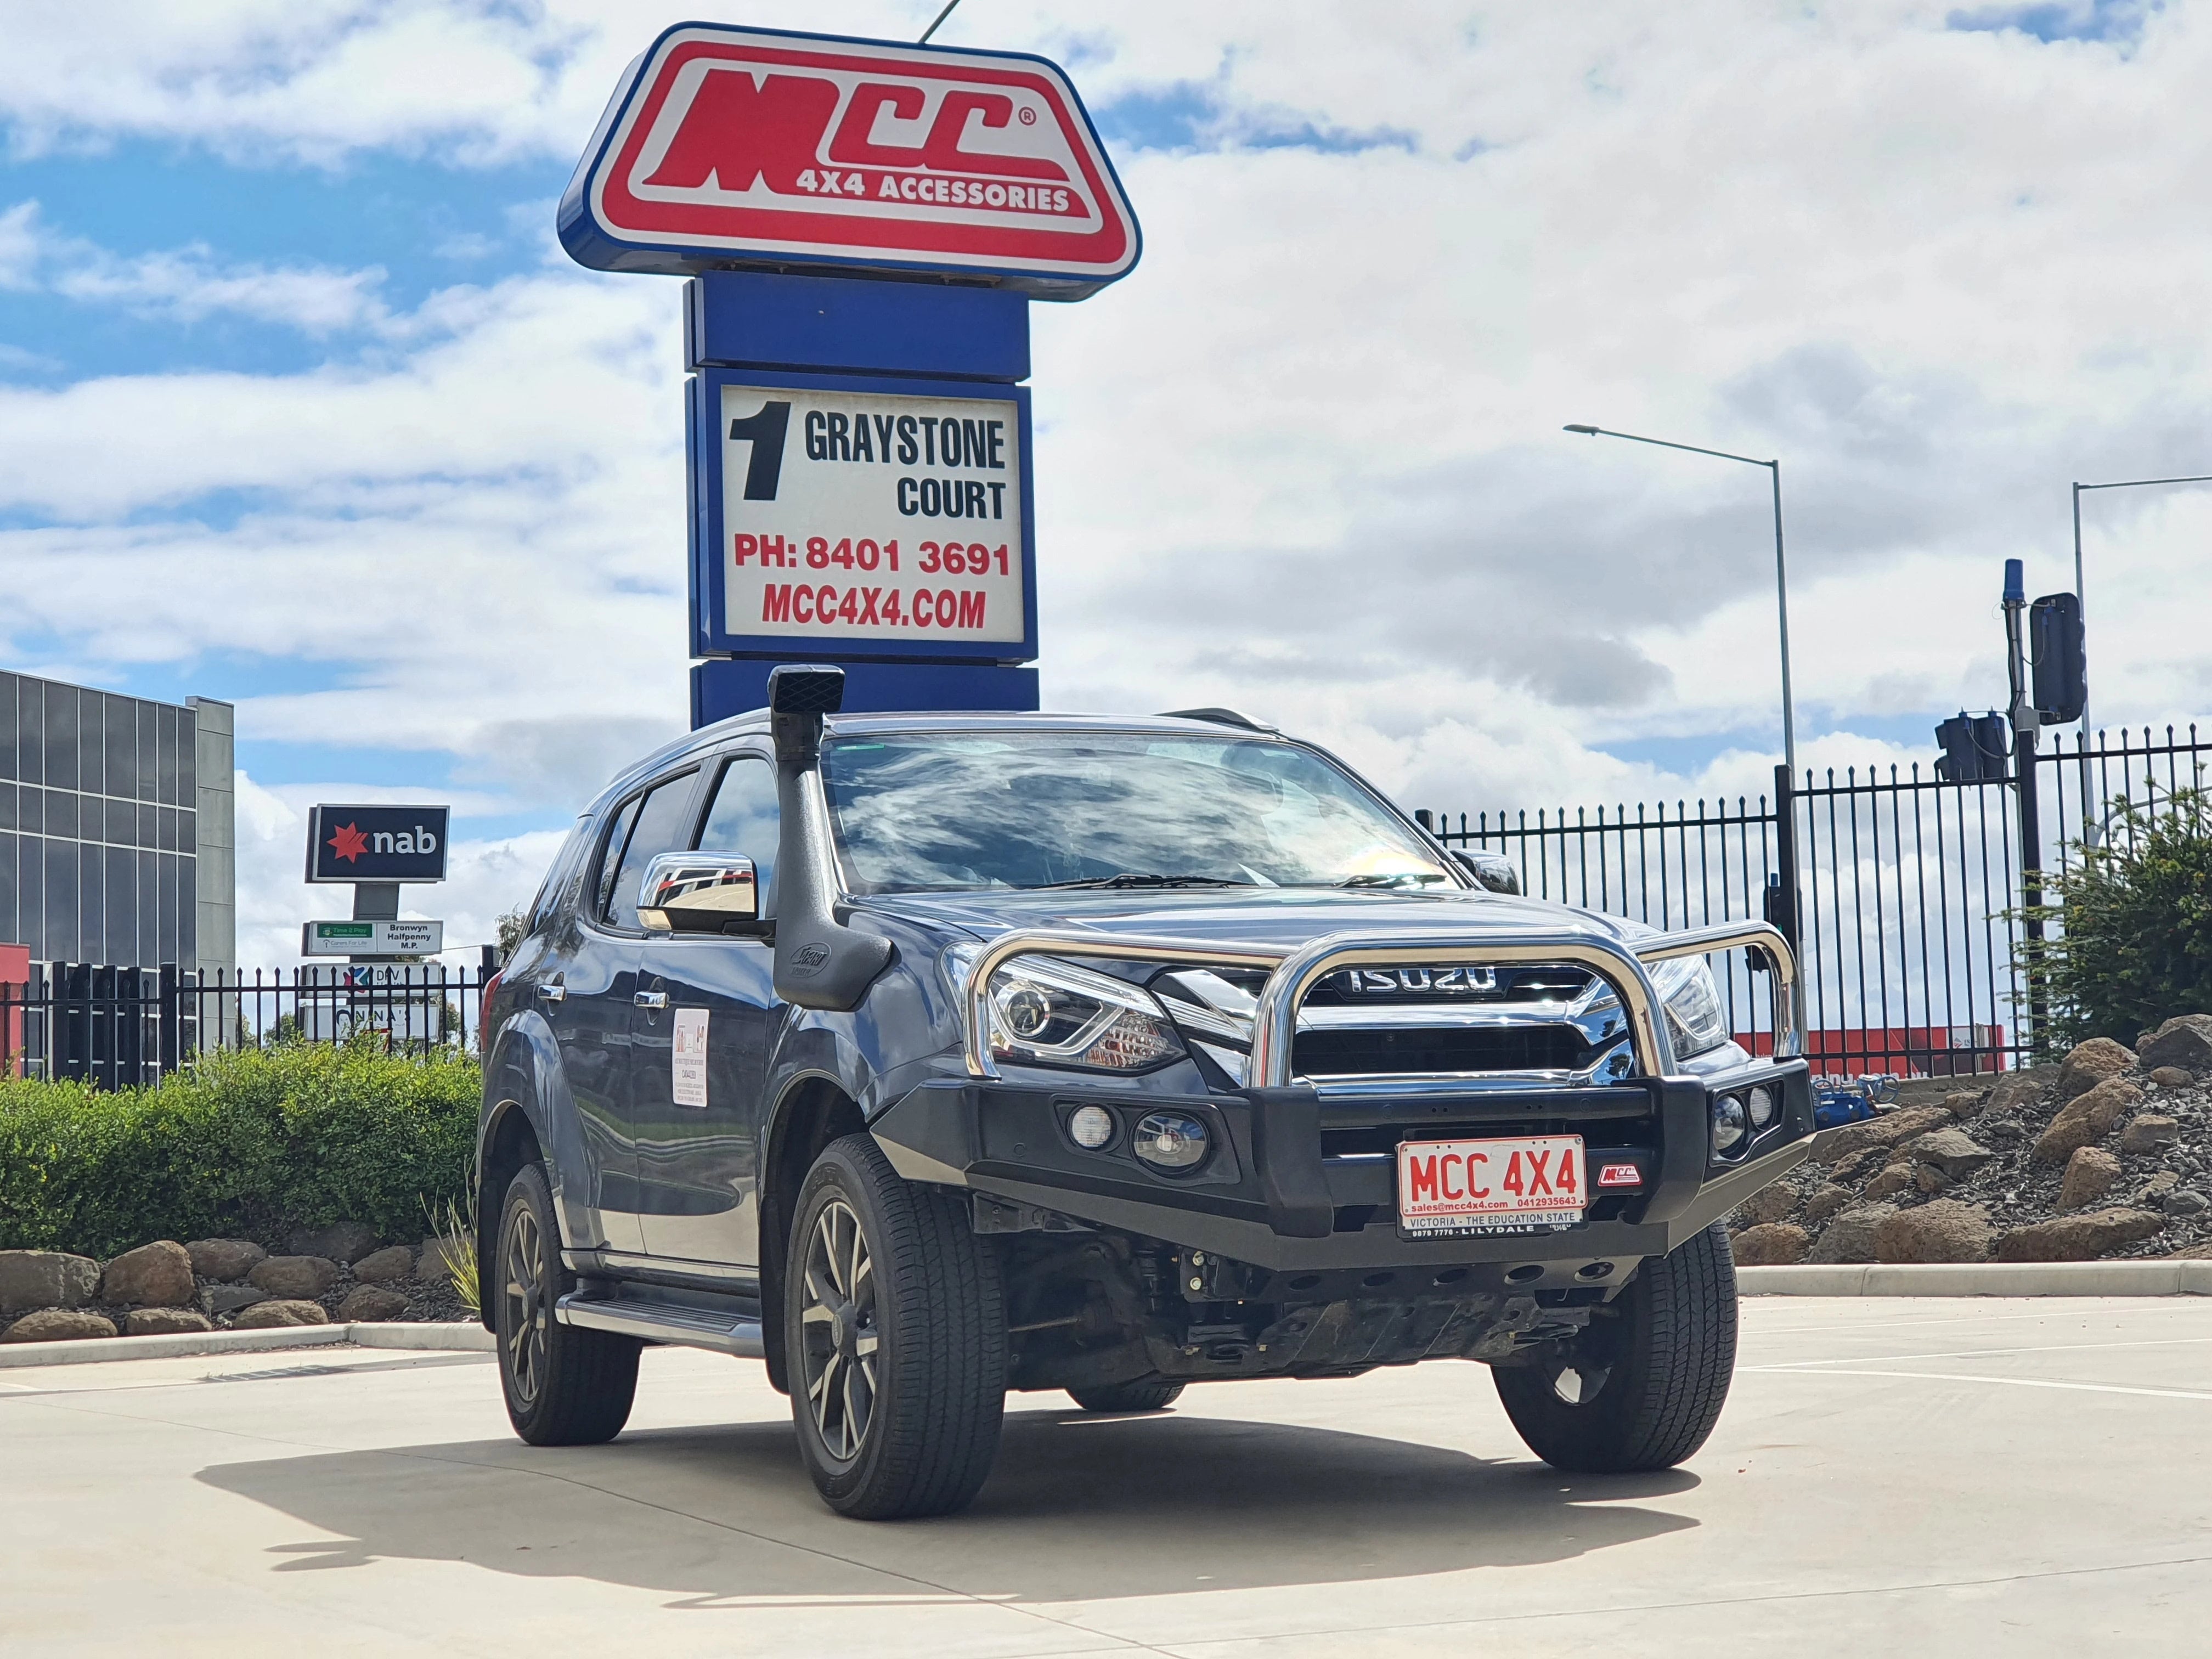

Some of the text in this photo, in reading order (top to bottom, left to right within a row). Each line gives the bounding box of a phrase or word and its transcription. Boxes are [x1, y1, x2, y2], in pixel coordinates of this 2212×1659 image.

[642, 69, 1069, 193] MCC
[796, 169, 1069, 212] 4X4 ACCESSORIES
[729, 401, 1005, 501] 1 GRAYSTONE
[898, 477, 1006, 520] COURT
[735, 533, 1008, 575] PH: 8401 3691
[762, 584, 986, 629] MCC4X4.COM
[374, 826, 436, 854] nab
[387, 933, 431, 941] Halfpenny
[390, 924, 428, 933] Bronwyn
[1350, 969, 1497, 992] ISUZU
[1409, 1149, 1576, 1202] MCC 4X4
[1603, 1168, 1636, 1181] MCC
[1412, 1197, 1576, 1212] sales@mcc4x4.com 0412935643
[1410, 1217, 1455, 1227] VICTORIA
[1466, 1215, 1485, 1224] THE
[1488, 1214, 1543, 1224] EDUCATION
[1547, 1212, 1575, 1222] STATE
[1462, 1226, 1534, 1234] LILYDALE
